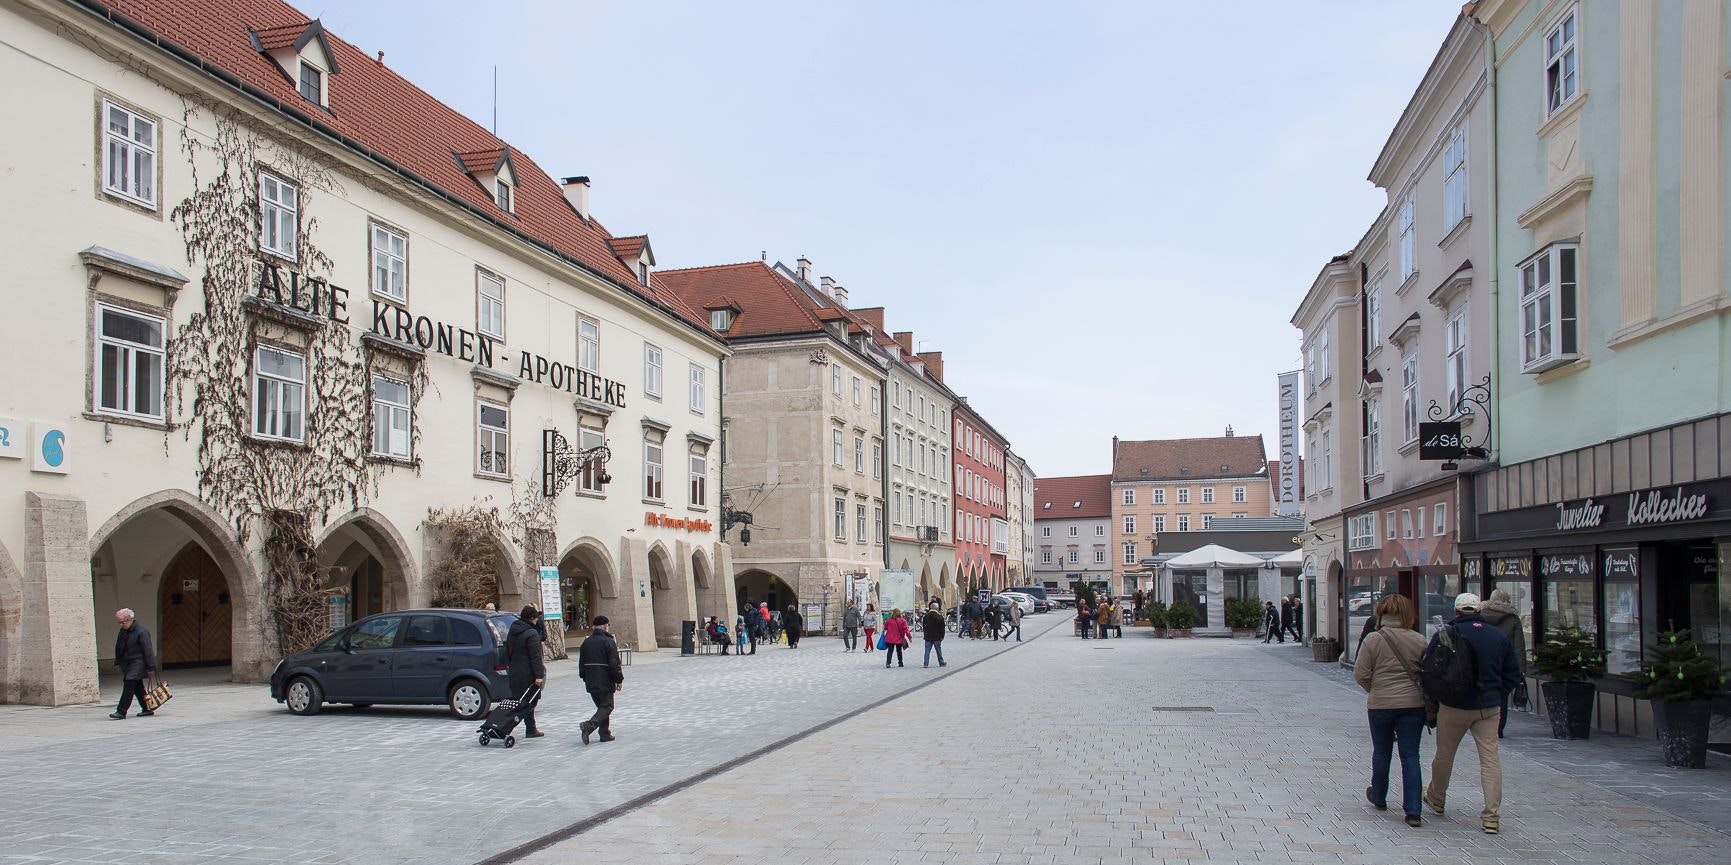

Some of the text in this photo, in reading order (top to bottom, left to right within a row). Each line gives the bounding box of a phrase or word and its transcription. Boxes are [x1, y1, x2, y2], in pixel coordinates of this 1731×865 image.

[258, 264, 350, 325] ALTE
[370, 299, 494, 369] KRONEN
[518, 350, 627, 409] APOTHEKE
[1281, 383, 1294, 504] DOROTHEUM
[1423, 434, 1459, 447] de Sá
[1556, 487, 1707, 530] Juwelier Kollecker
